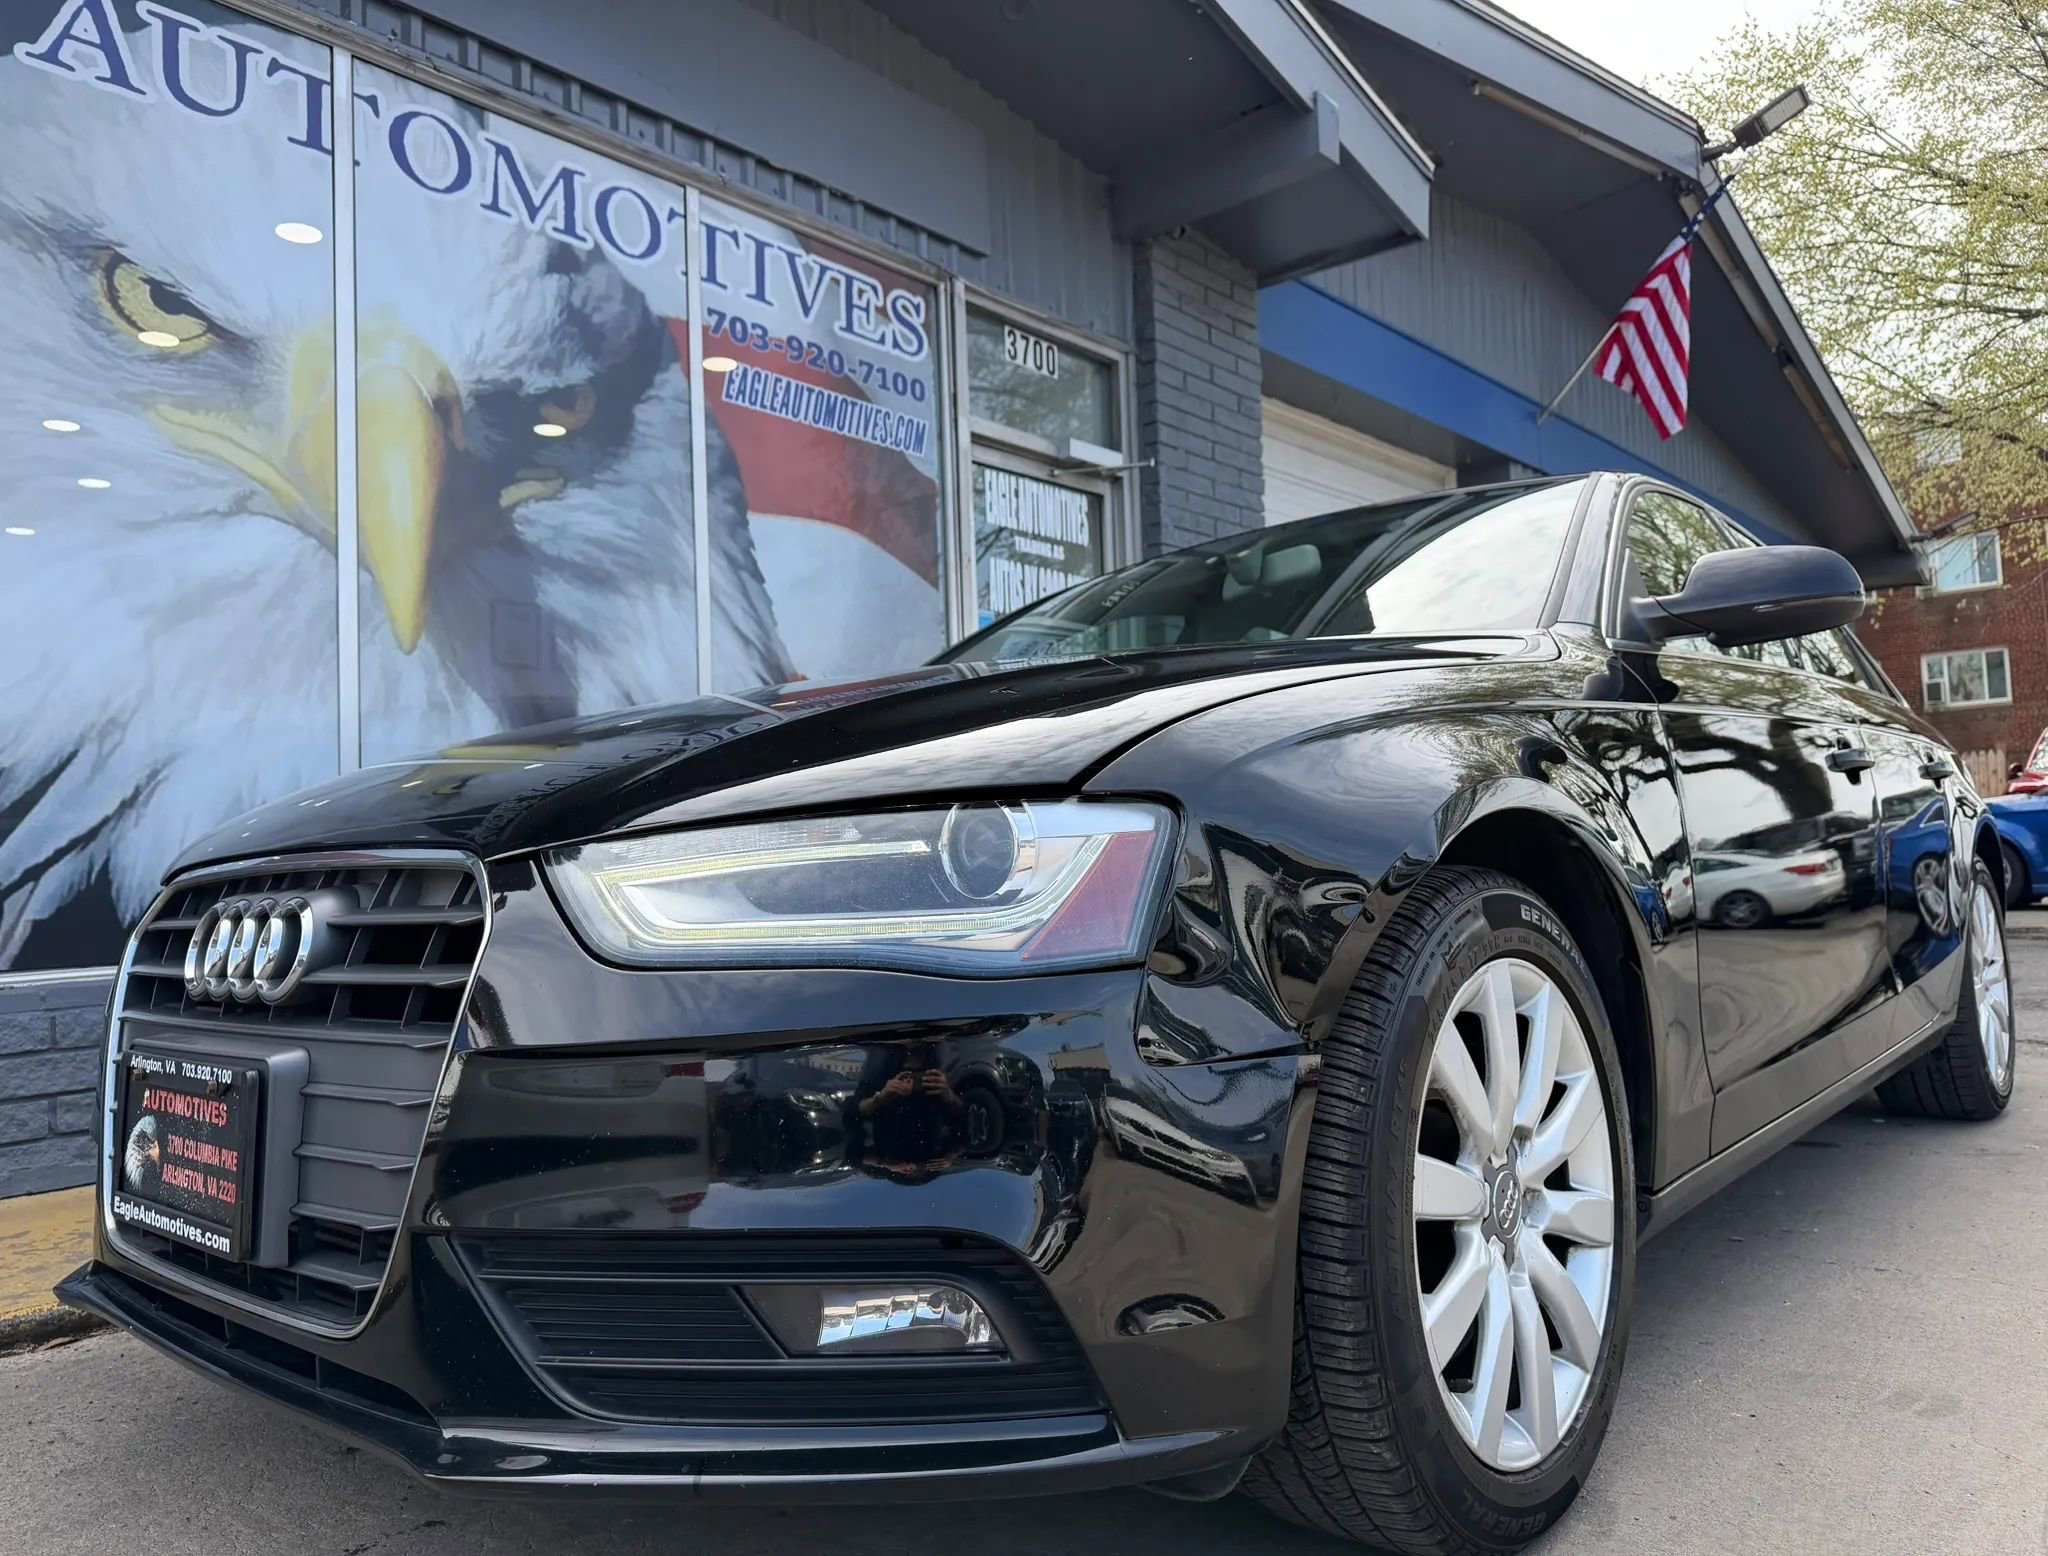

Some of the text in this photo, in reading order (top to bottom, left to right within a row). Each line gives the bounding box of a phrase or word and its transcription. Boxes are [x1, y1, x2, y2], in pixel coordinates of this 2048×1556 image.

[24, 0, 925, 357] AUTOMOTIVES
[706, 307, 926, 403] 703-920-7100
[1007, 328, 1056, 377] 3700
[723, 365, 928, 456] EAGLEAUTOMOTIVES.COM
[984, 468, 1090, 548] EAGLE AUTOMOTIVES
[1520, 903, 1588, 979] GENERAL
[130, 1054, 232, 1085] Arlington, VA 703.920.7100
[143, 1087, 228, 1127] AUTOMOTIVES
[184, 1138, 220, 1167] COLUMBIA
[220, 1148, 238, 1172] PIKE
[207, 1175, 218, 1198] VA
[113, 1195, 231, 1253] EagleAutomotives.com
